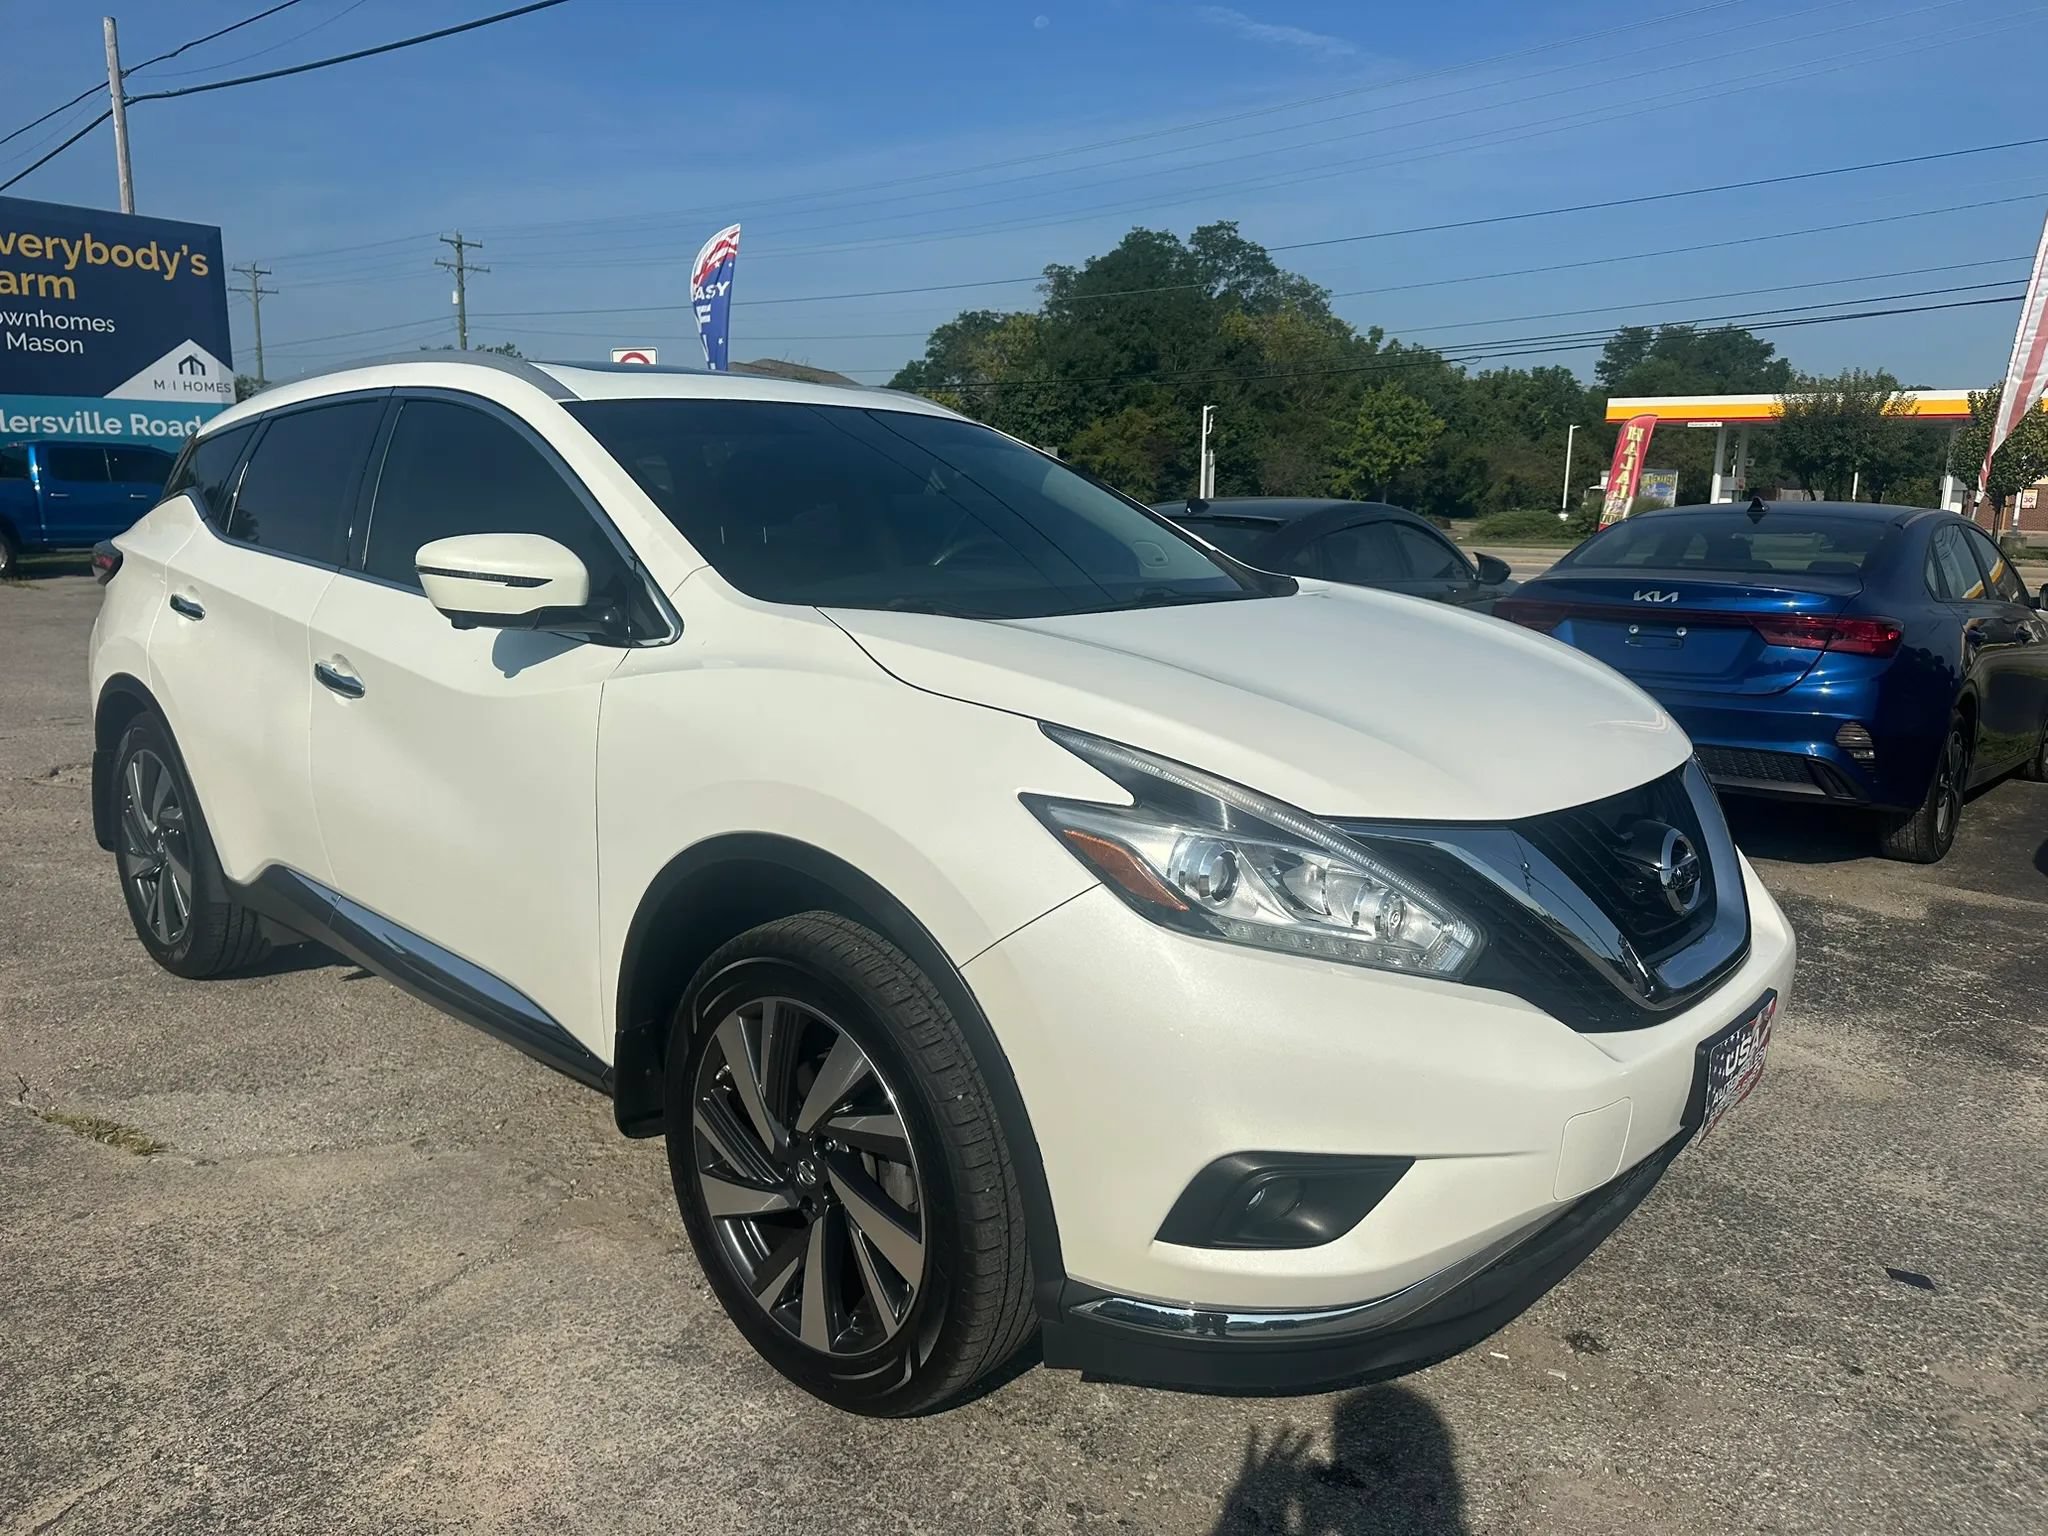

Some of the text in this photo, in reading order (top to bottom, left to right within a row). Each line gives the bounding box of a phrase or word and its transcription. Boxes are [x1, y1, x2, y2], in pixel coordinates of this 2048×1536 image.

[0, 309, 116, 333] wnhomes
[6, 332, 84, 354] Mason
[183, 381, 232, 394] HOMES
[130, 413, 202, 437] Road
[1726, 1027, 1760, 1077] USA
